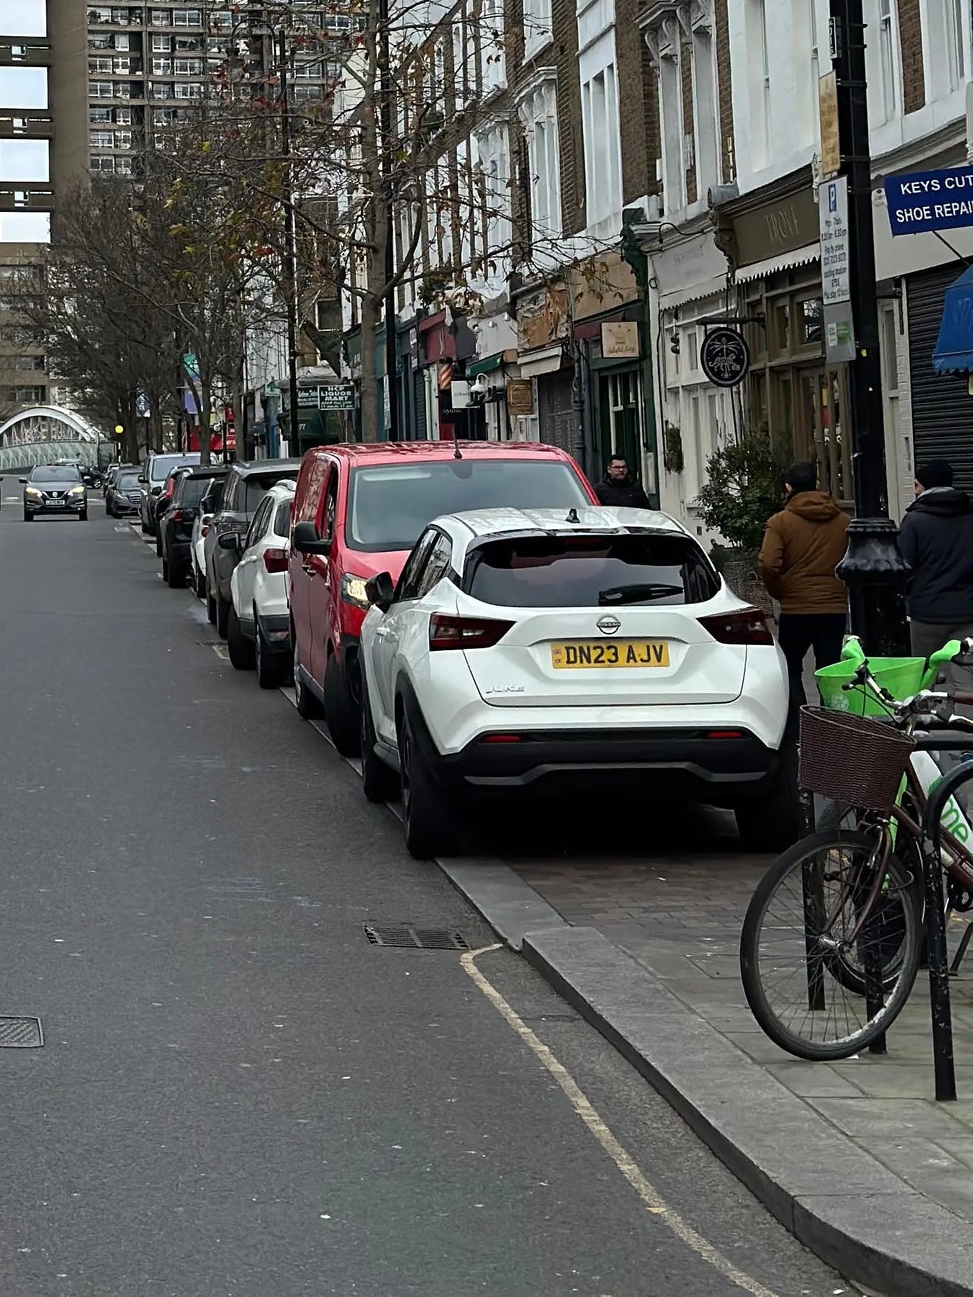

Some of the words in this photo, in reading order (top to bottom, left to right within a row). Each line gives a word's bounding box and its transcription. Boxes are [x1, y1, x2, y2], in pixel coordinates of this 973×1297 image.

[900, 179, 941, 195] KEYS
[944, 174, 973, 189] CUT
[895, 205, 932, 223] SHOE
[934, 200, 973, 218] REPAI
[564, 645, 619, 664] DN23
[626, 644, 664, 663] AJV
